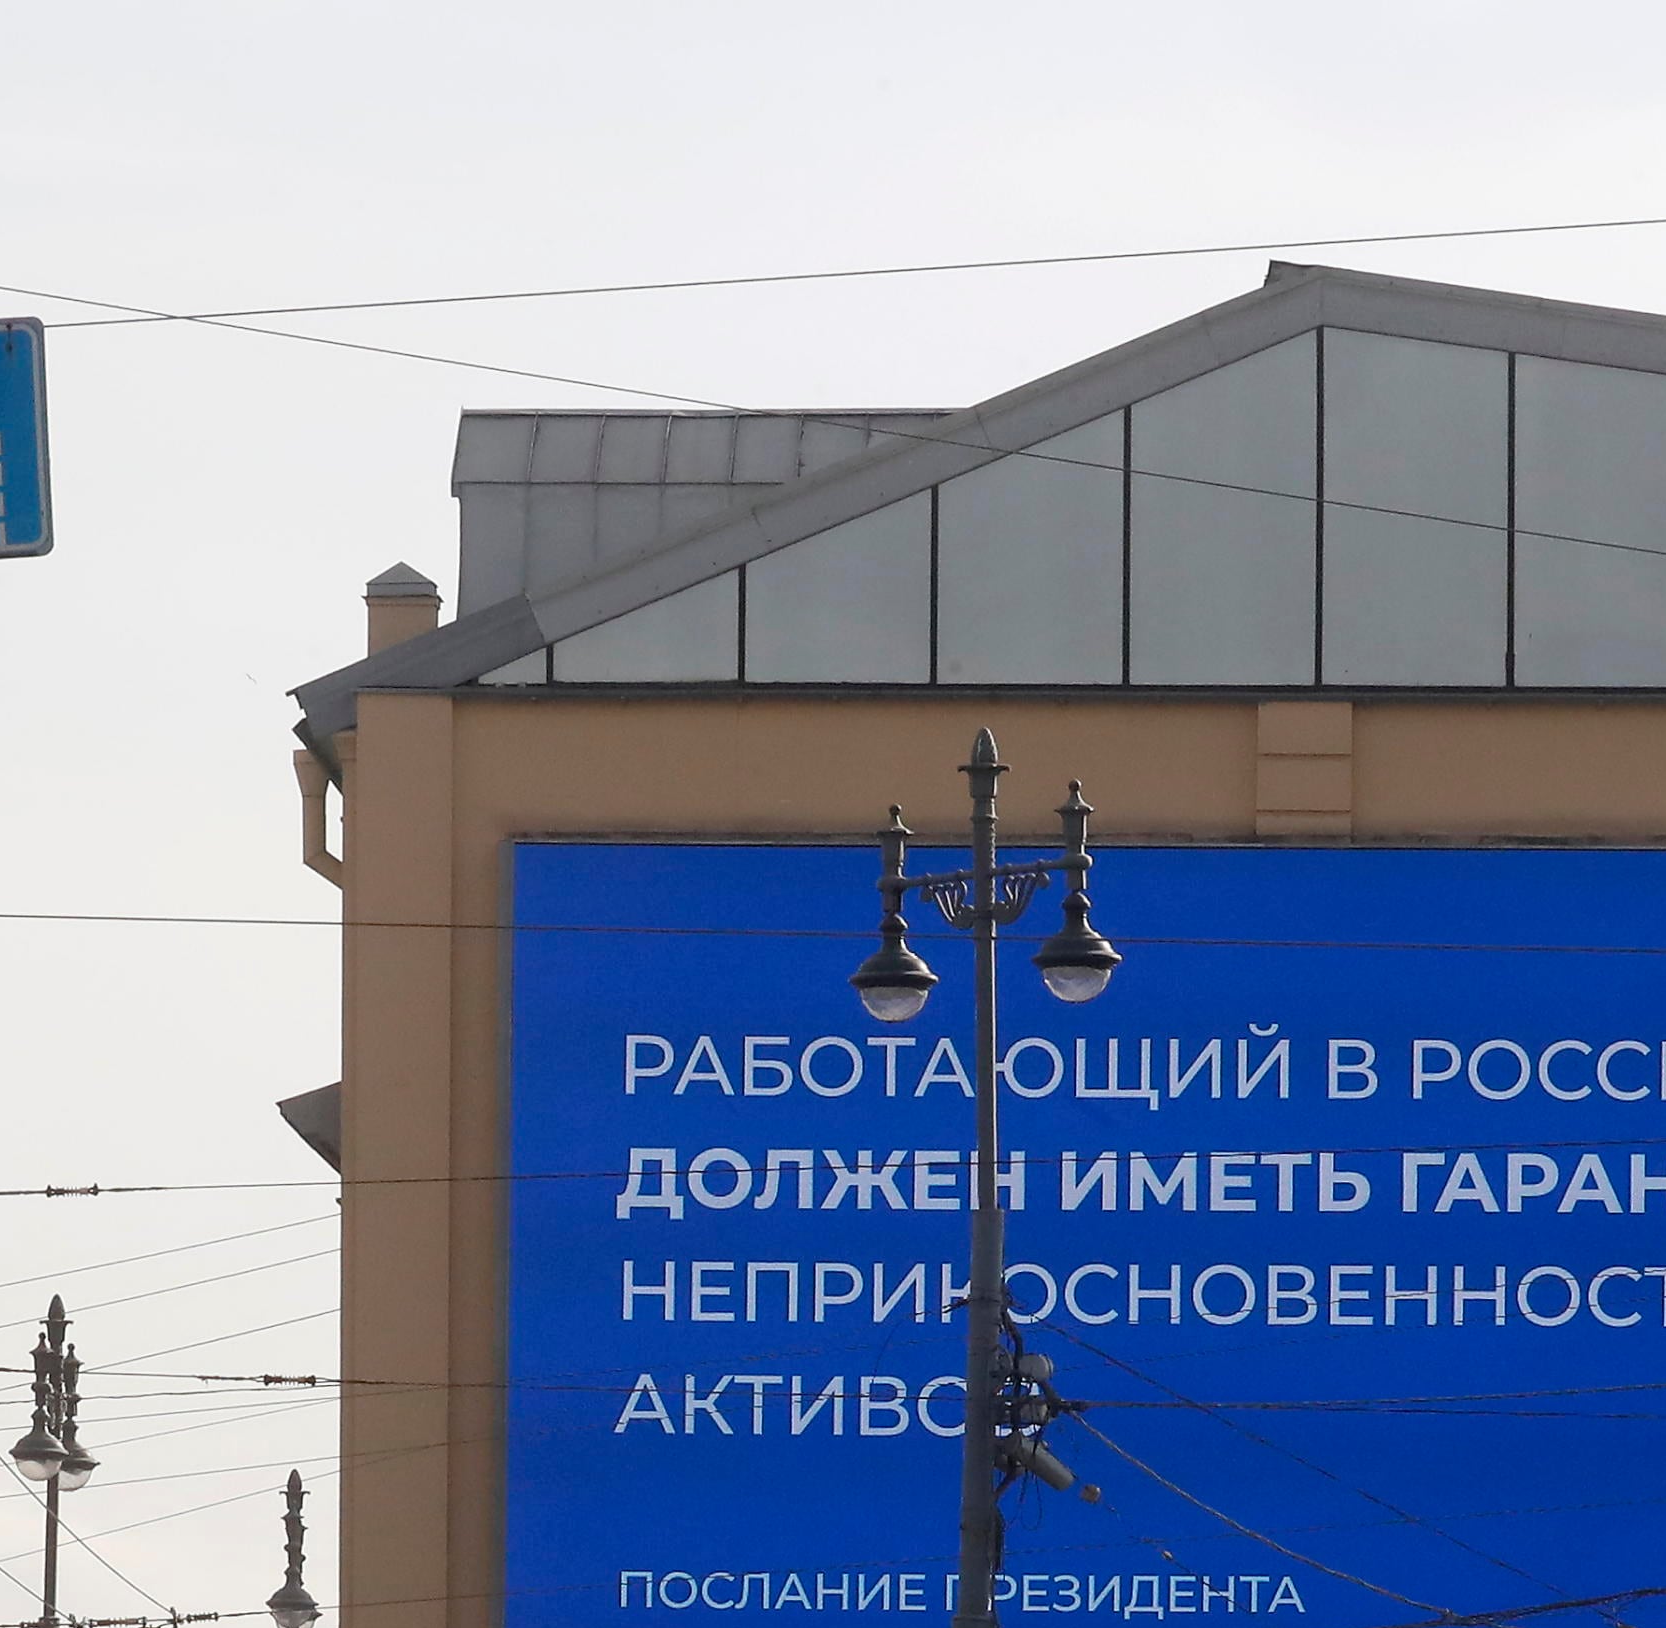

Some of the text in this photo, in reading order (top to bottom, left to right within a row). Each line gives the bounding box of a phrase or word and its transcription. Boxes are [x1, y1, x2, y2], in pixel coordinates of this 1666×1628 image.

[1328, 1035, 1378, 1099] В
[1061, 1151, 1372, 1213] ИМЕТЬ
[618, 1570, 927, 1612] ПОСЛАНИЕ
